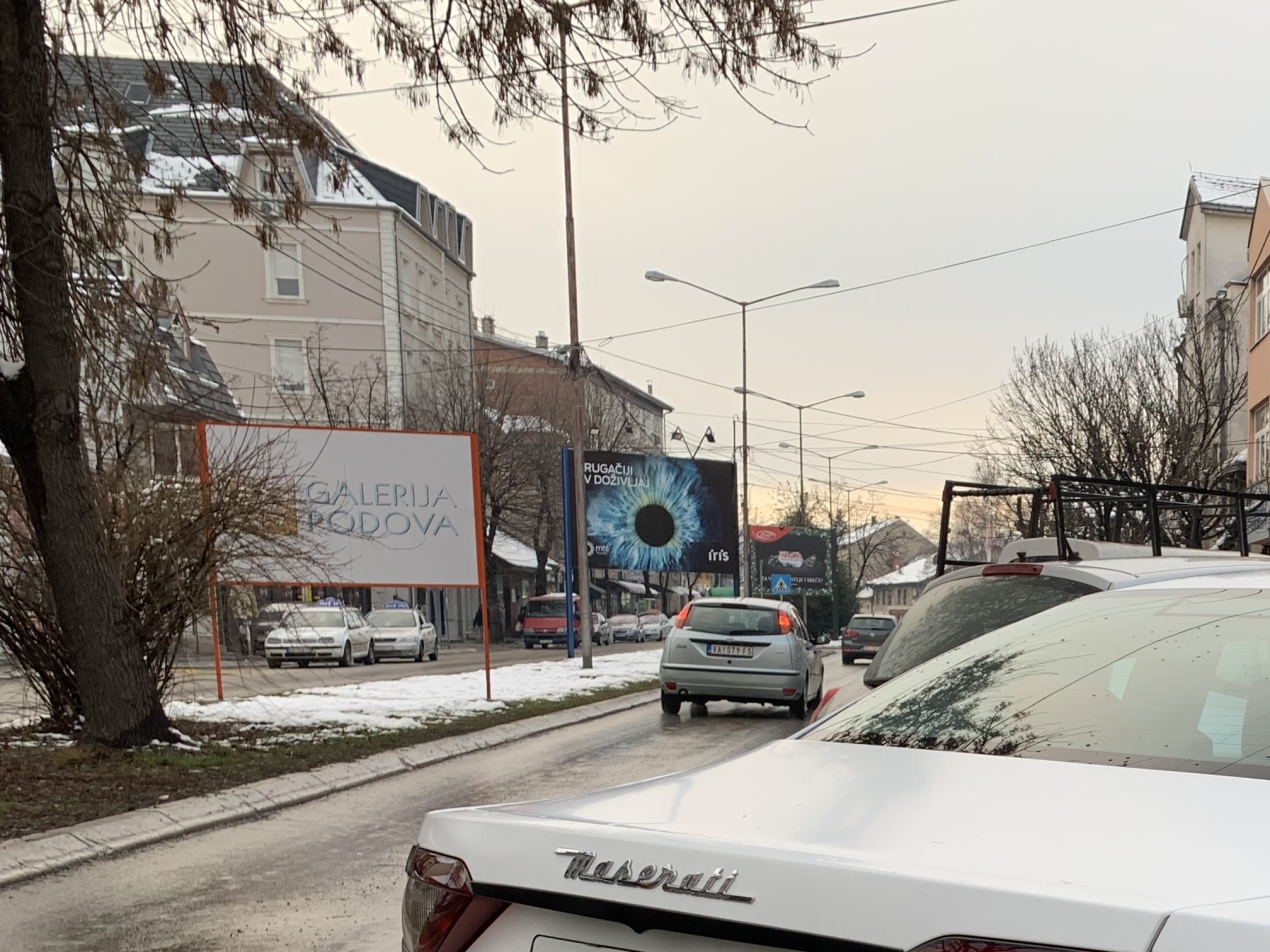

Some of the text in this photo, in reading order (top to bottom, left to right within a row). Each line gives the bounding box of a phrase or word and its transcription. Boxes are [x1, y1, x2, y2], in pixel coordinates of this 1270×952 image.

[594, 473, 650, 488] DOŽIVLJAJ
[307, 481, 458, 508] GALERIJA
[307, 510, 459, 536] PODOVA
[708, 549, 730, 562] iris
[554, 847, 756, 904] Maserati
